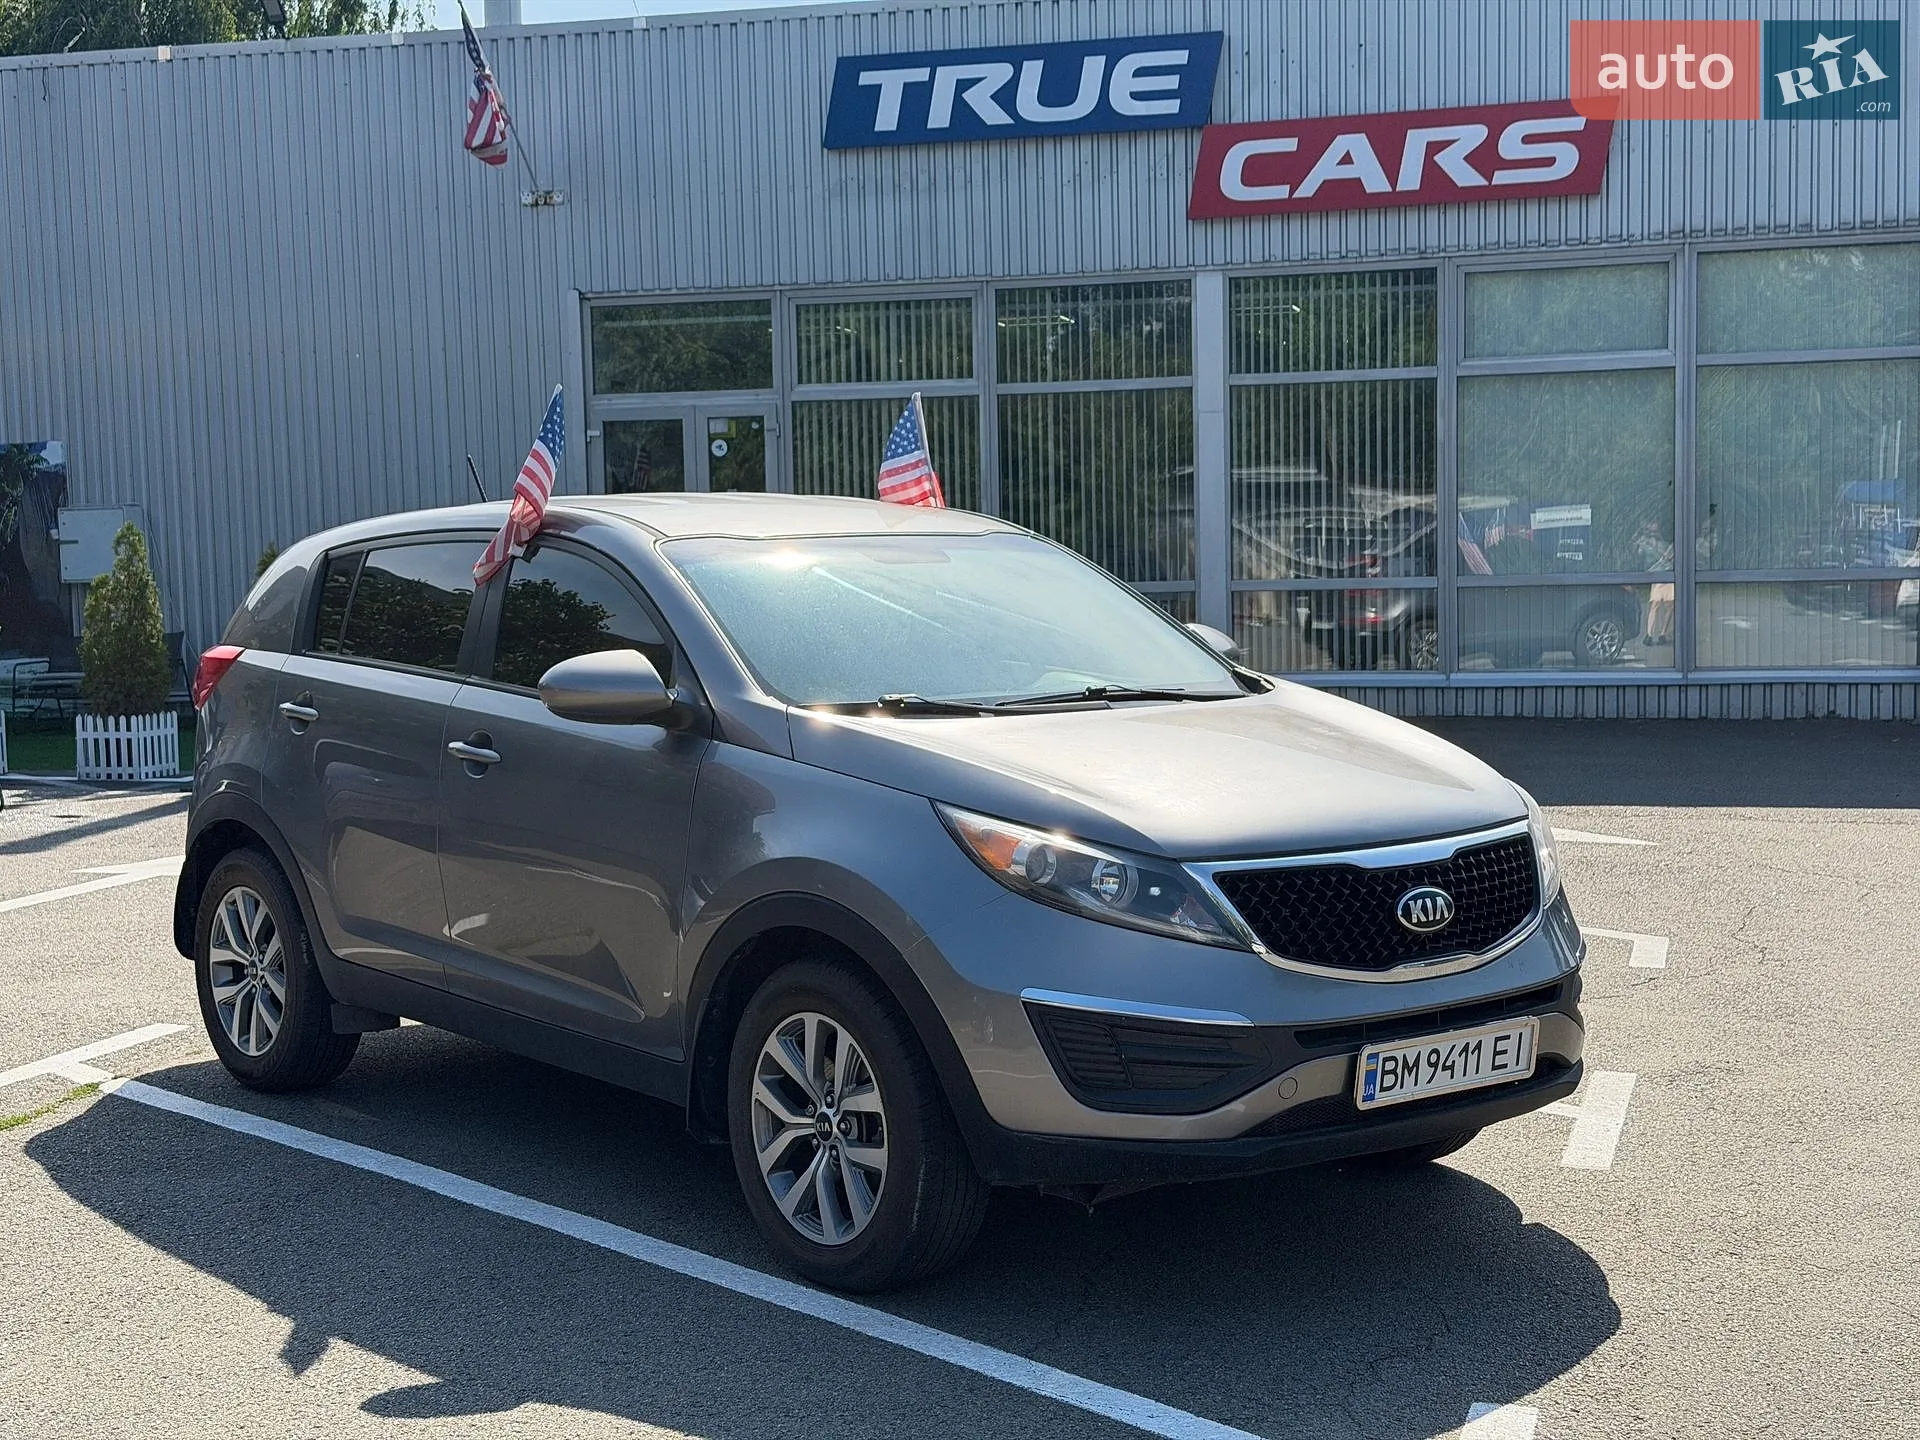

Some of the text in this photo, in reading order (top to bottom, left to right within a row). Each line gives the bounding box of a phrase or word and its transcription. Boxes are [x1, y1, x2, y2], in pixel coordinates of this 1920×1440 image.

[857, 49, 1189, 132] TRUE
[1219, 116, 1587, 202] CARS
[1408, 896, 1449, 924] KIA
[1426, 1039, 1483, 1084] 9411
[815, 1122, 831, 1132] KIA
